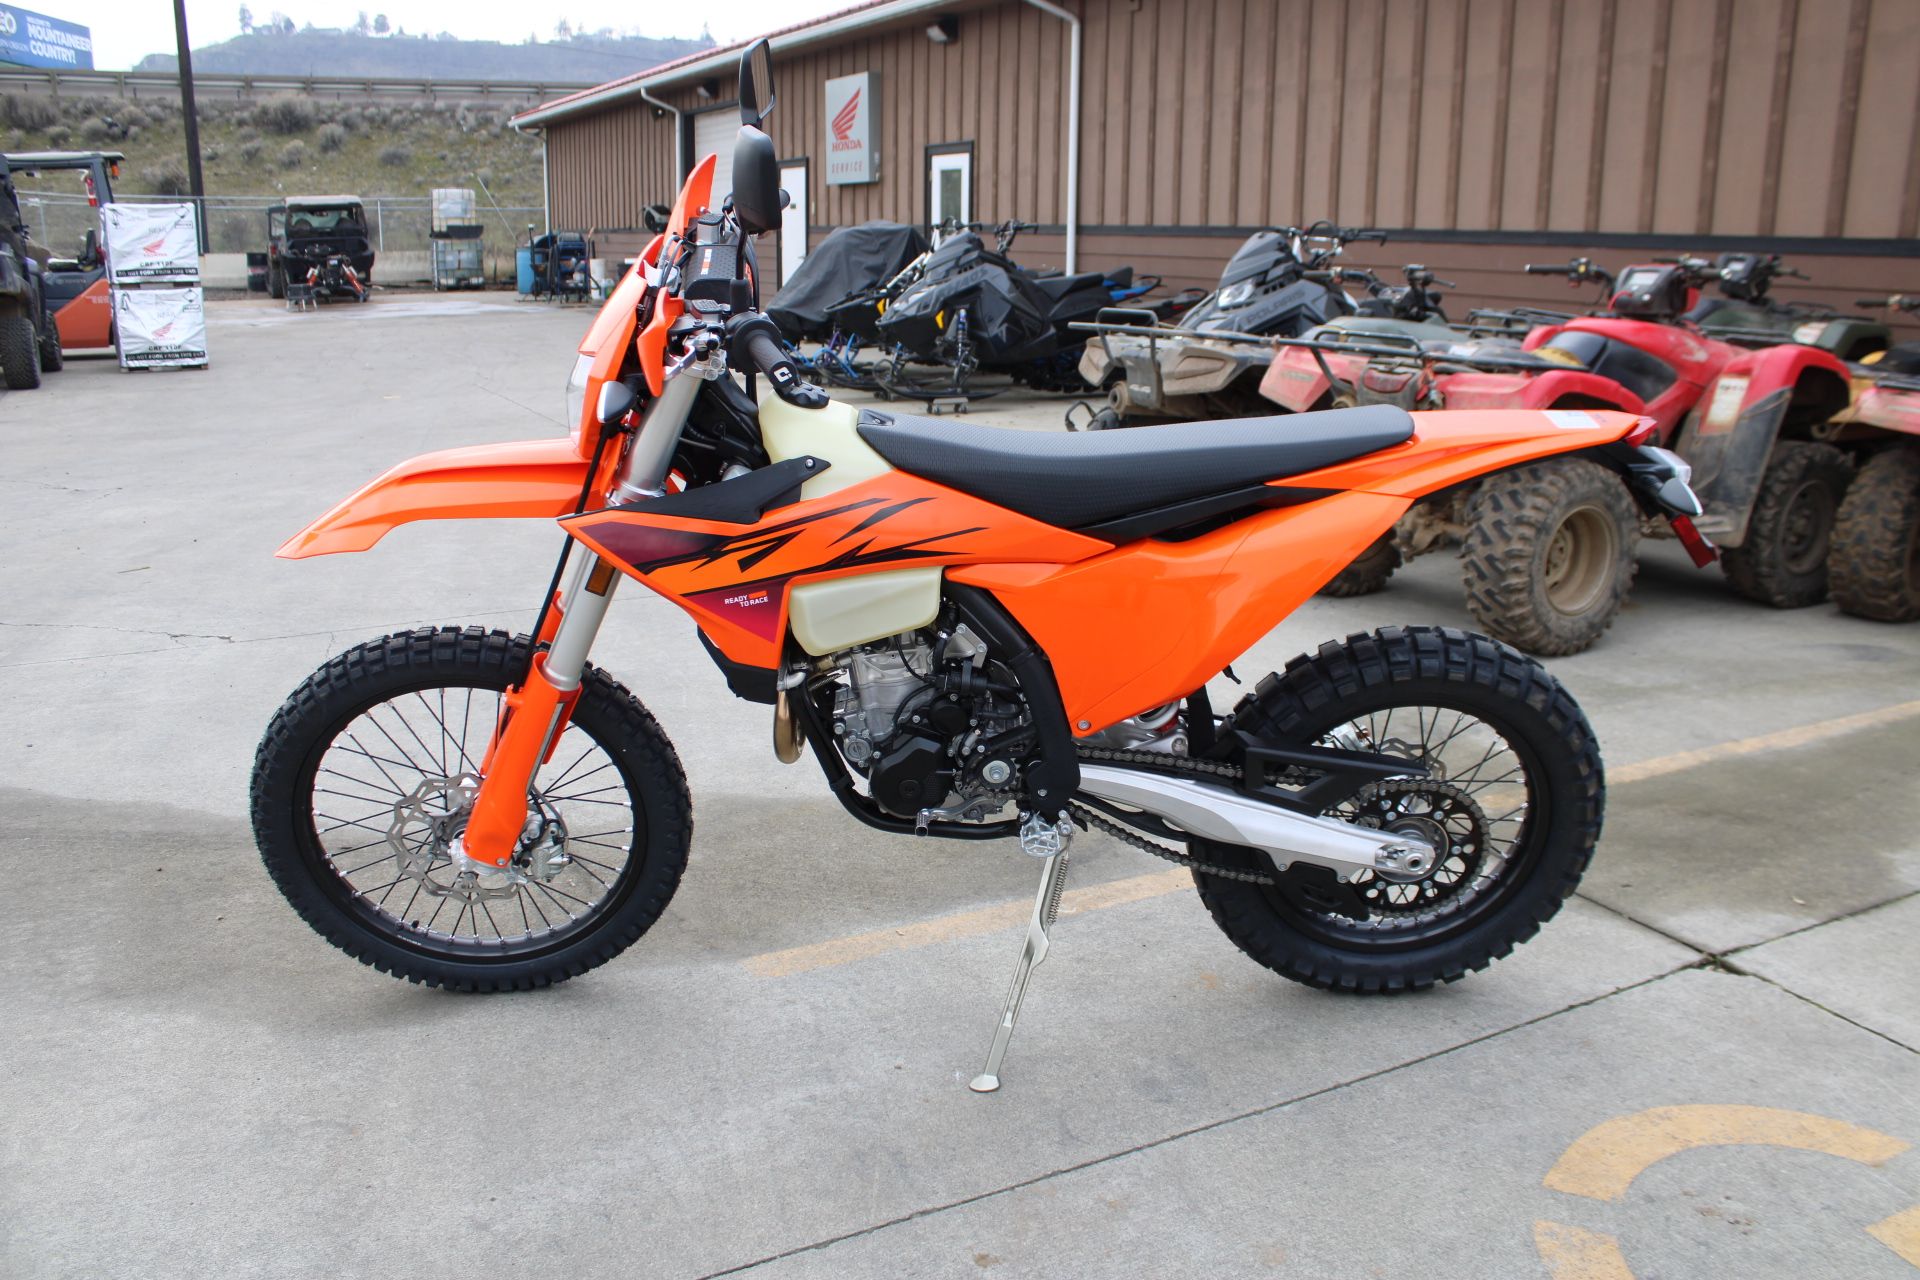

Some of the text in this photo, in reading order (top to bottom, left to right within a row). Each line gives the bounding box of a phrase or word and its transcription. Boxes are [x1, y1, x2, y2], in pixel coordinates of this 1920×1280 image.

[27, 22, 92, 52] MOUNTAINEER
[30, 40, 77, 64] COUNTRY!
[831, 138, 863, 152] HONDA
[831, 160, 864, 174] SERVICE
[1246, 288, 1306, 322] POLARIS
[724, 594, 748, 605] READY
[750, 595, 769, 606] RACE
